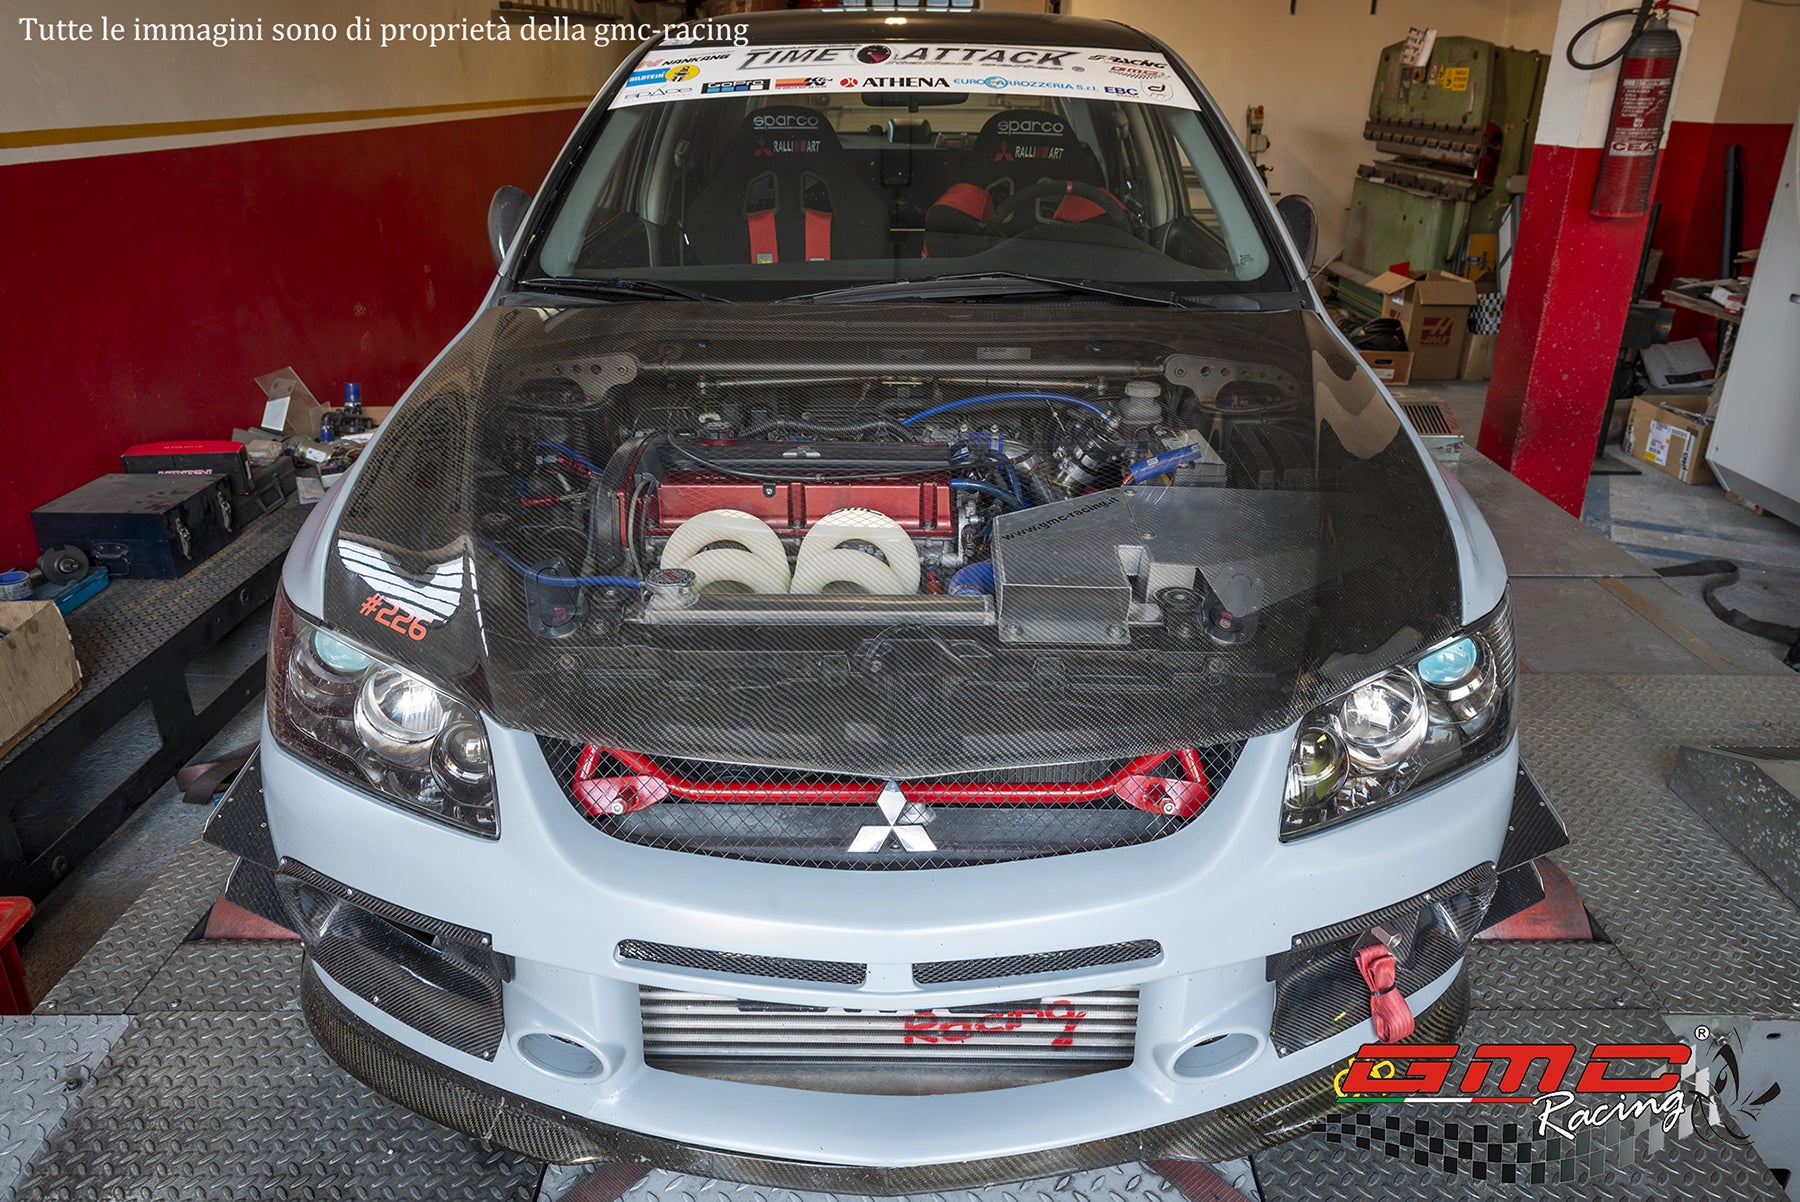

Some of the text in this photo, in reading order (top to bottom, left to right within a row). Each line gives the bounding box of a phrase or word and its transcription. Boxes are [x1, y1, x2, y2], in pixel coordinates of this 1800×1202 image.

[661, 53, 731, 66] NANKANG
[738, 48, 852, 68] TIME
[902, 47, 1076, 66] ATTACK
[629, 72, 665, 83] BILSTEIN
[862, 77, 950, 88] ATHENA
[1104, 86, 1139, 96] EBC
[753, 114, 819, 130] sparco
[998, 119, 1064, 136] sparco
[1001, 496, 1119, 541] www.gmc-racing.it
[359, 593, 434, 641] #226
[904, 1000, 1086, 1048] Racing
